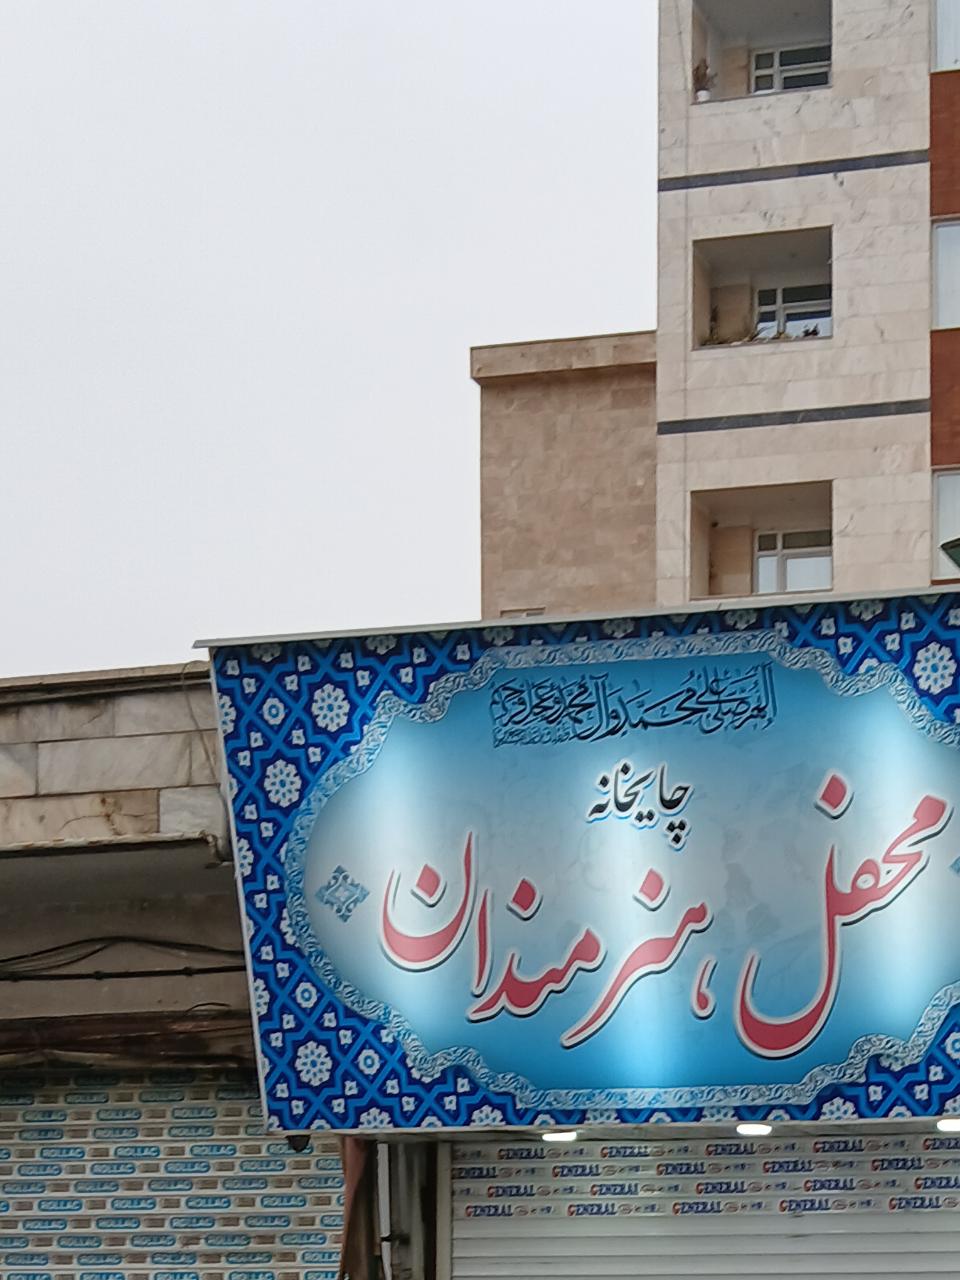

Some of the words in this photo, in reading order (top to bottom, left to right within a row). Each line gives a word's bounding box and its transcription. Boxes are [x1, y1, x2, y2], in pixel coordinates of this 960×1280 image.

[588, 762, 691, 844] چایخانه
[381, 830, 713, 1048] هنرمندان
[738, 773, 948, 1055] محفل
